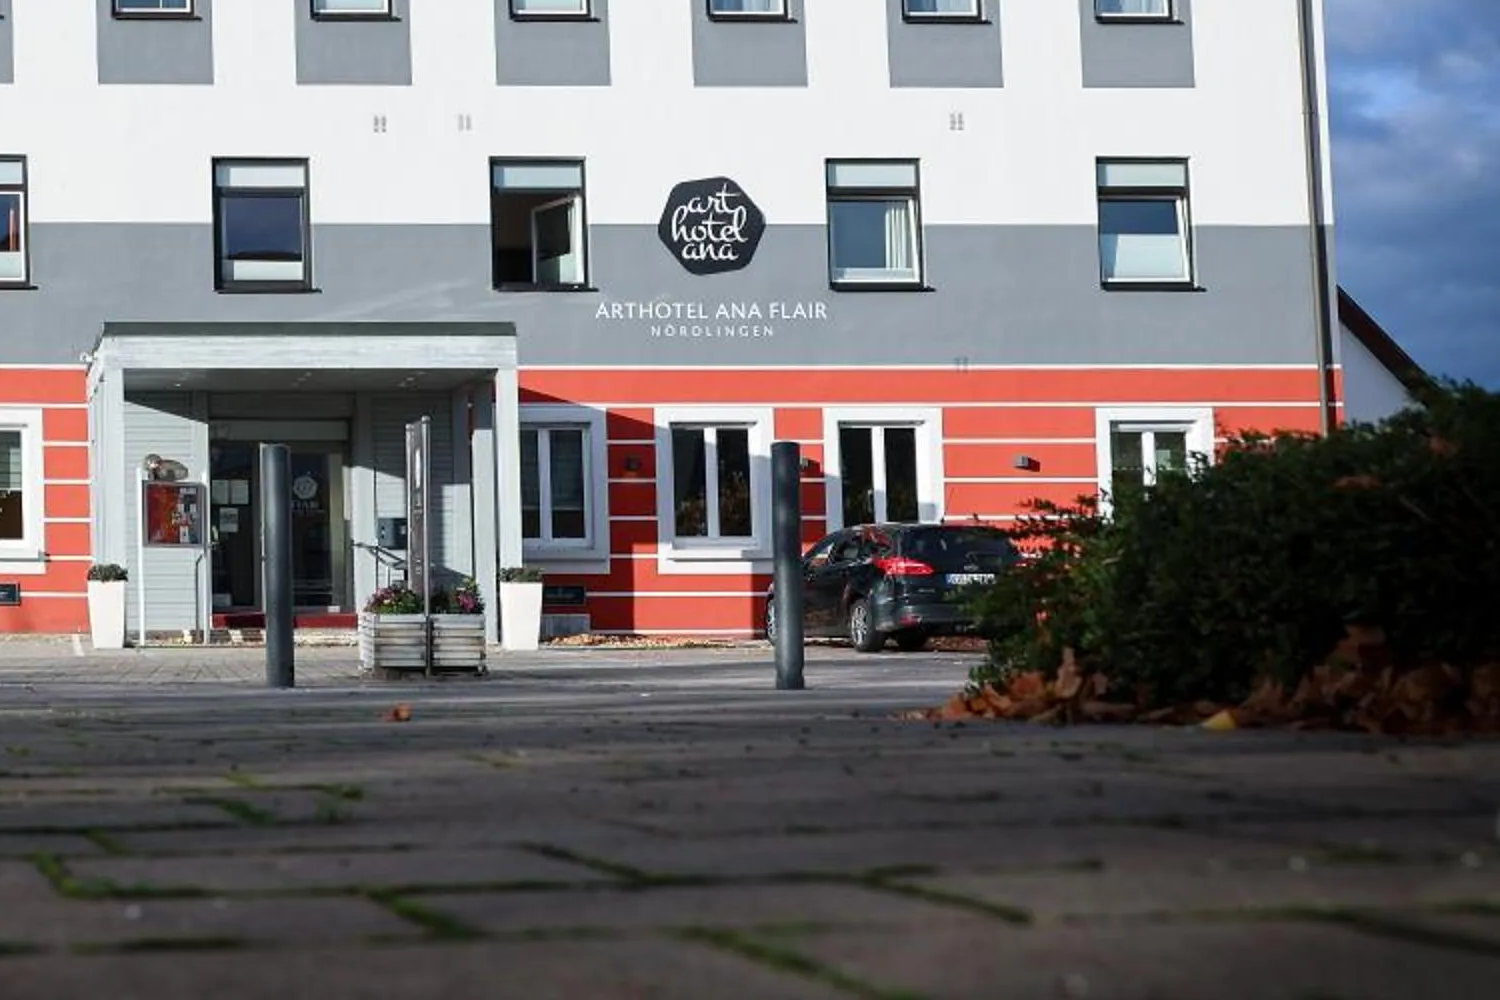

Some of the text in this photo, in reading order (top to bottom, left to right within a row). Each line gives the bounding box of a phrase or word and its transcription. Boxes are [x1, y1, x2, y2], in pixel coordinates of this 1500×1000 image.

[687, 183, 741, 214] art
[671, 205, 748, 243] hotel
[682, 242, 739, 260] ana
[595, 302, 828, 319] ARTHOTEL ANA FLAIR
